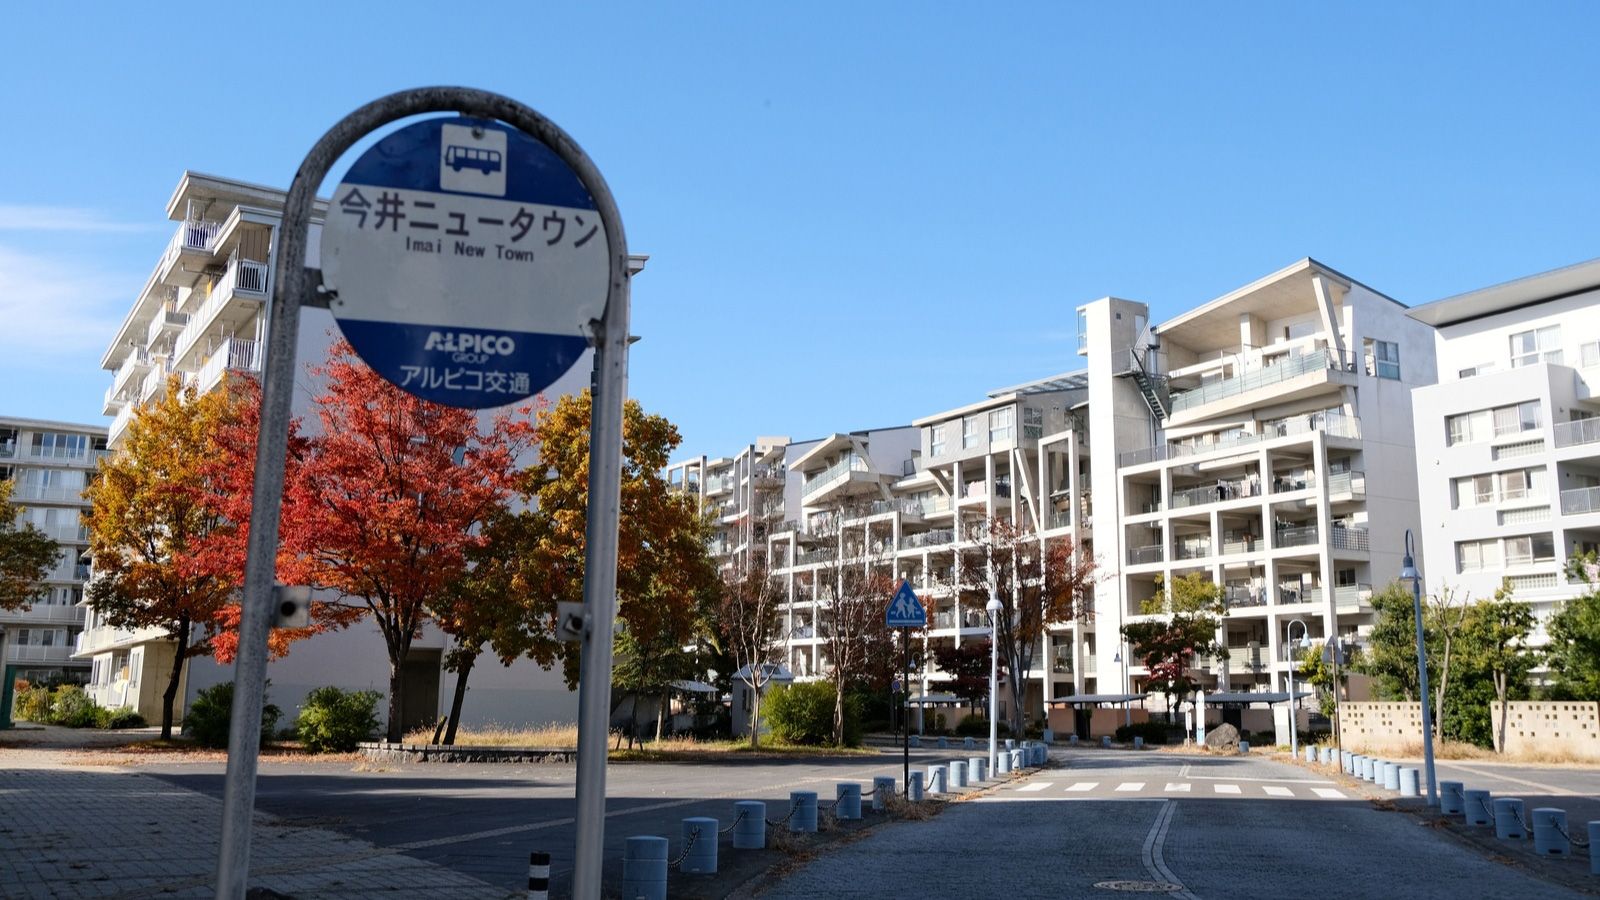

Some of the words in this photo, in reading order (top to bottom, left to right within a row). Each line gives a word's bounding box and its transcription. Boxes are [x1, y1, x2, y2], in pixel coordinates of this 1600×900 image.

[340, 188, 598, 248] 今井ニュータウン
[406, 236, 442, 253] Imai
[454, 241, 486, 258] New
[495, 244, 535, 263] Town
[424, 331, 515, 356] ALPICO
[452, 352, 490, 364] GROUP
[400, 365, 530, 394] アルピコ交通
